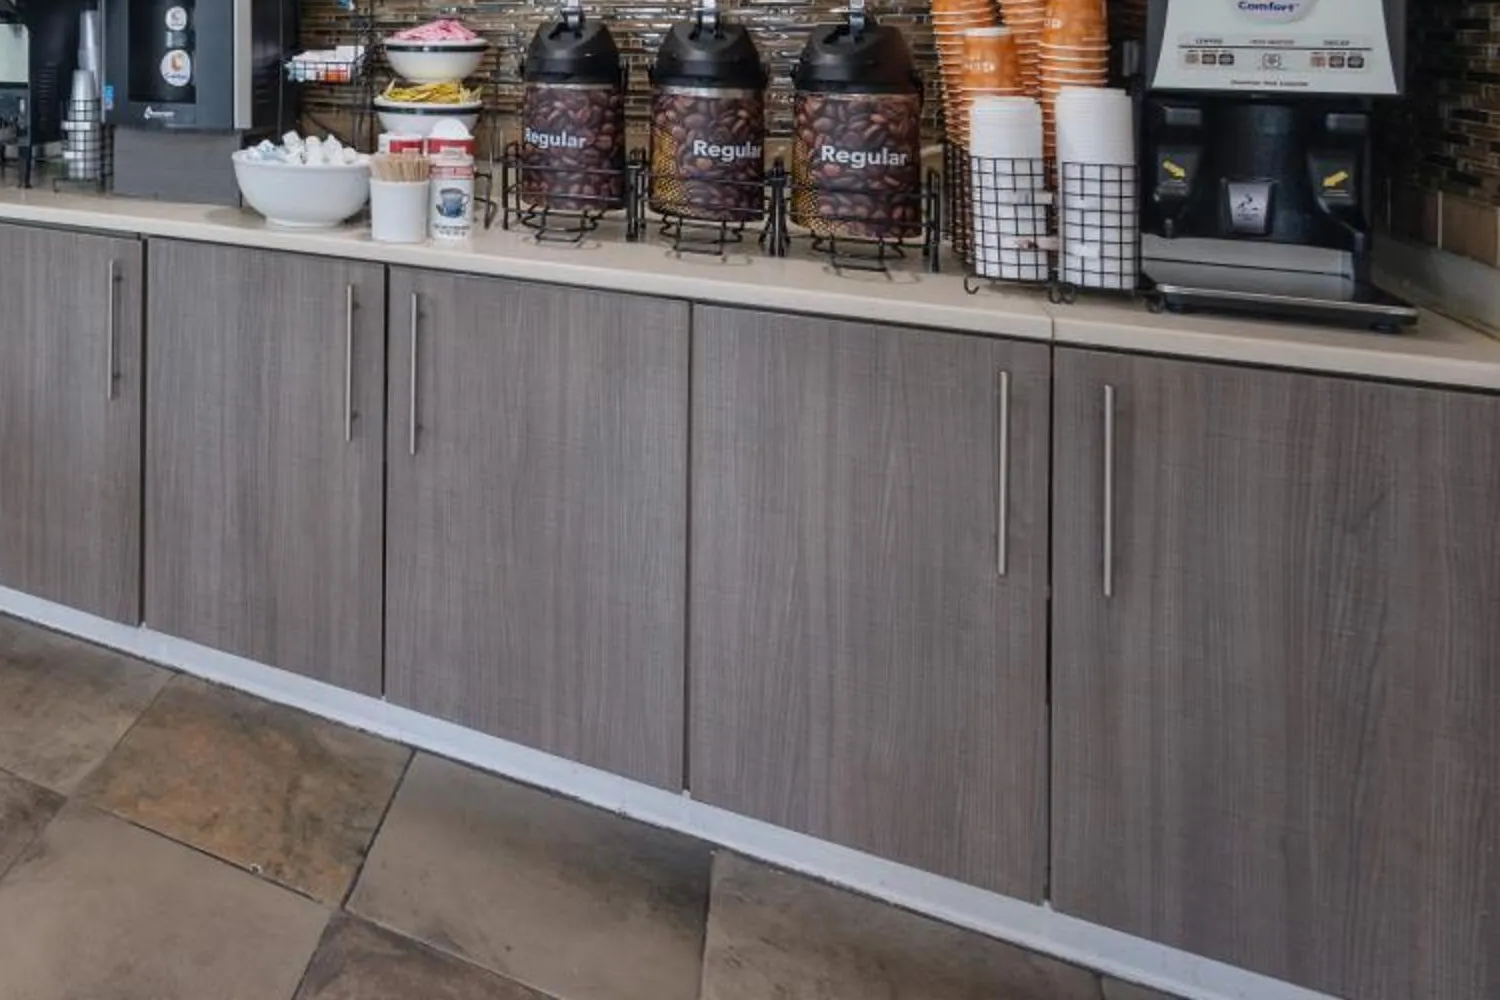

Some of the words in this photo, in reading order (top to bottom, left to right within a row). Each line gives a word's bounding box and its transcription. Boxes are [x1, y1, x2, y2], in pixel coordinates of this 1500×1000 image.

[1238, 1, 1294, 12] Comfort
[693, 139, 761, 162] Regular
[821, 145, 907, 169] Regular
